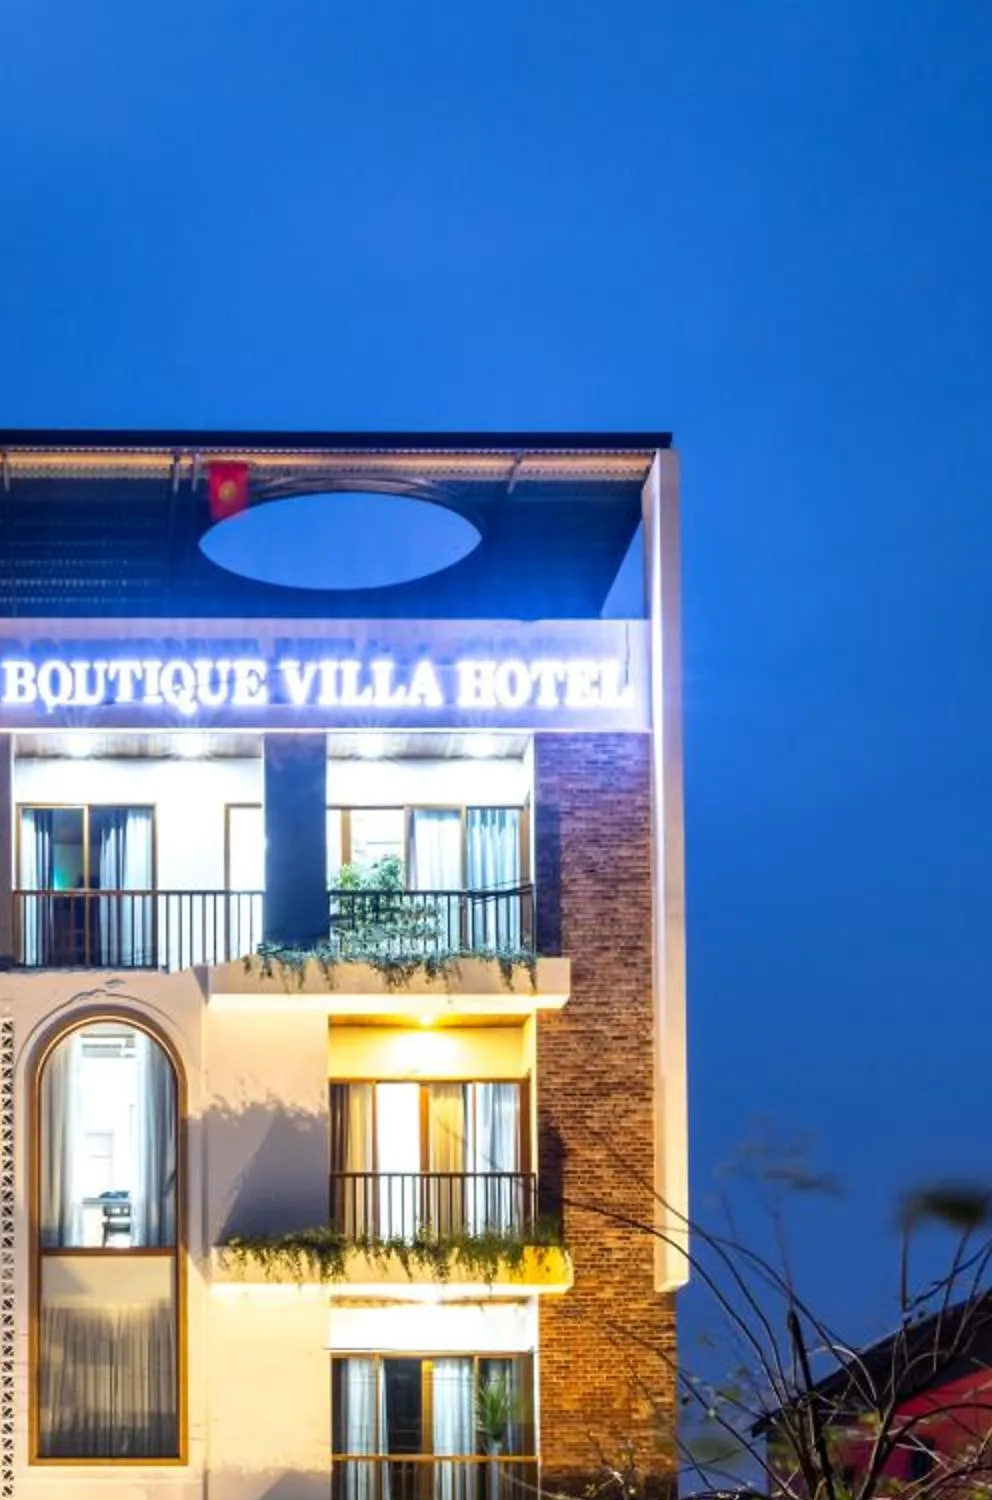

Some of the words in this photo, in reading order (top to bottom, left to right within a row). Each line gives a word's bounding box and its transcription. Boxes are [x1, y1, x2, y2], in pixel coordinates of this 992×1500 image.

[1, 660, 268, 714] BOUTIQUE
[280, 660, 444, 706] VILLA
[456, 660, 634, 706] HOTEL
